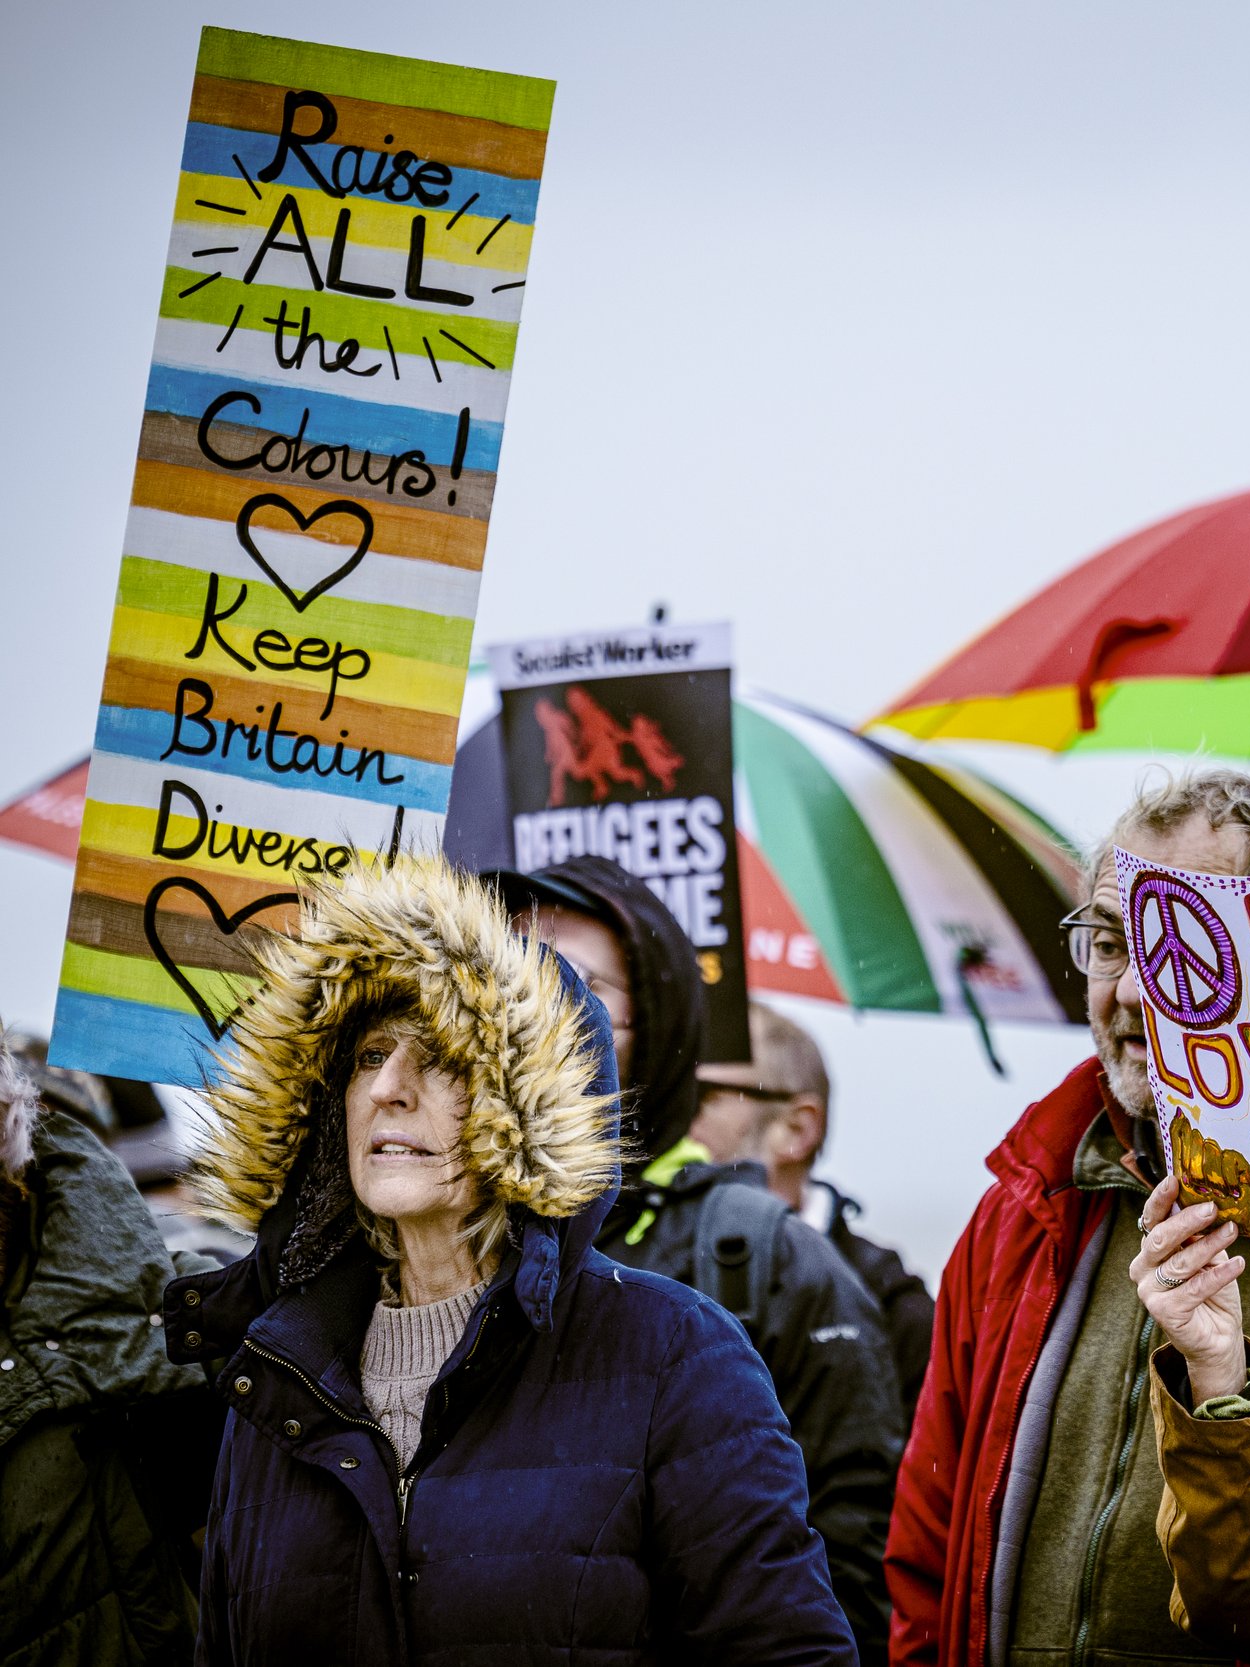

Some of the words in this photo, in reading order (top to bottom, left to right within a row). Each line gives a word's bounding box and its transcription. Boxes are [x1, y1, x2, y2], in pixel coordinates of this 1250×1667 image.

[257, 90, 454, 207] Raise
[243, 193, 474, 306] ALL
[263, 299, 382, 377] the
[197, 390, 470, 506] Colours!
[185, 572, 371, 718] Keep
[515, 648, 595, 674] Socialist
[602, 639, 695, 664] Worker
[160, 678, 404, 785] Britain
[513, 796, 727, 878] REFUGEES
